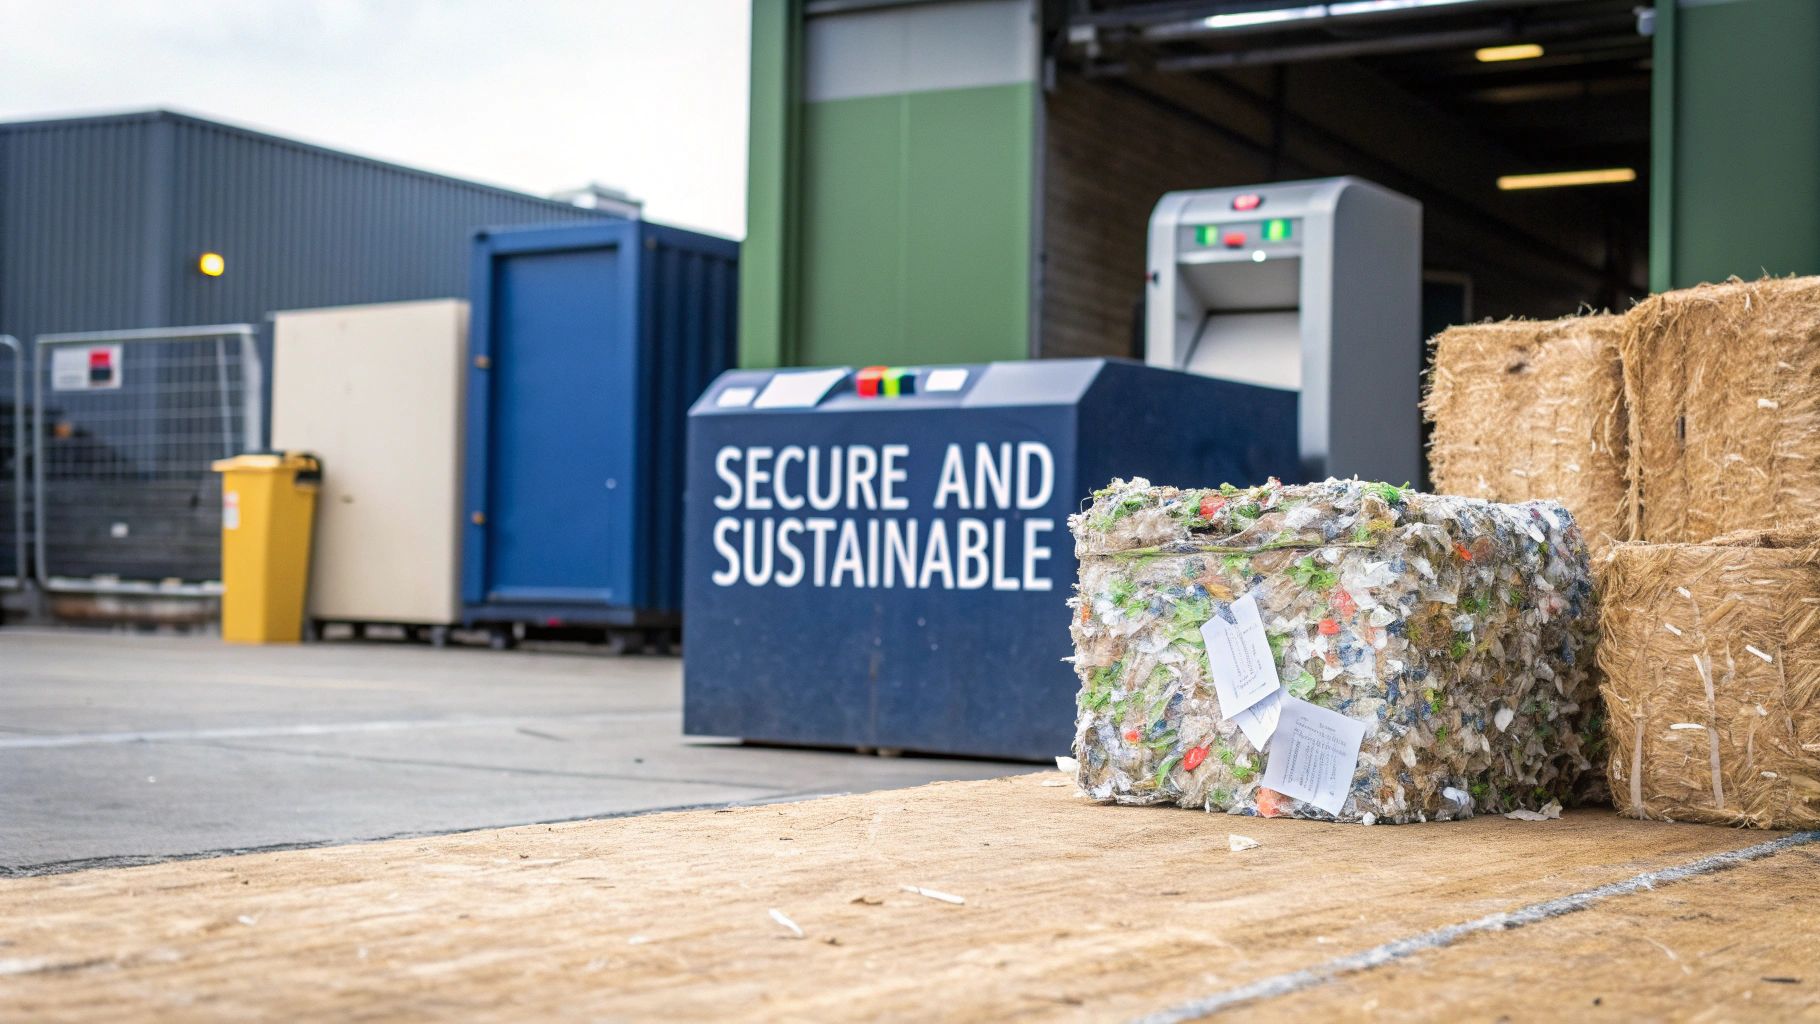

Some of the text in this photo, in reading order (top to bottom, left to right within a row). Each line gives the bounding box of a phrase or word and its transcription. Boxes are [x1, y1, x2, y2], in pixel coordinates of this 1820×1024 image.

[713, 441, 1055, 511] SECURE AND
[711, 517, 1055, 592] SUSTAINABLE
